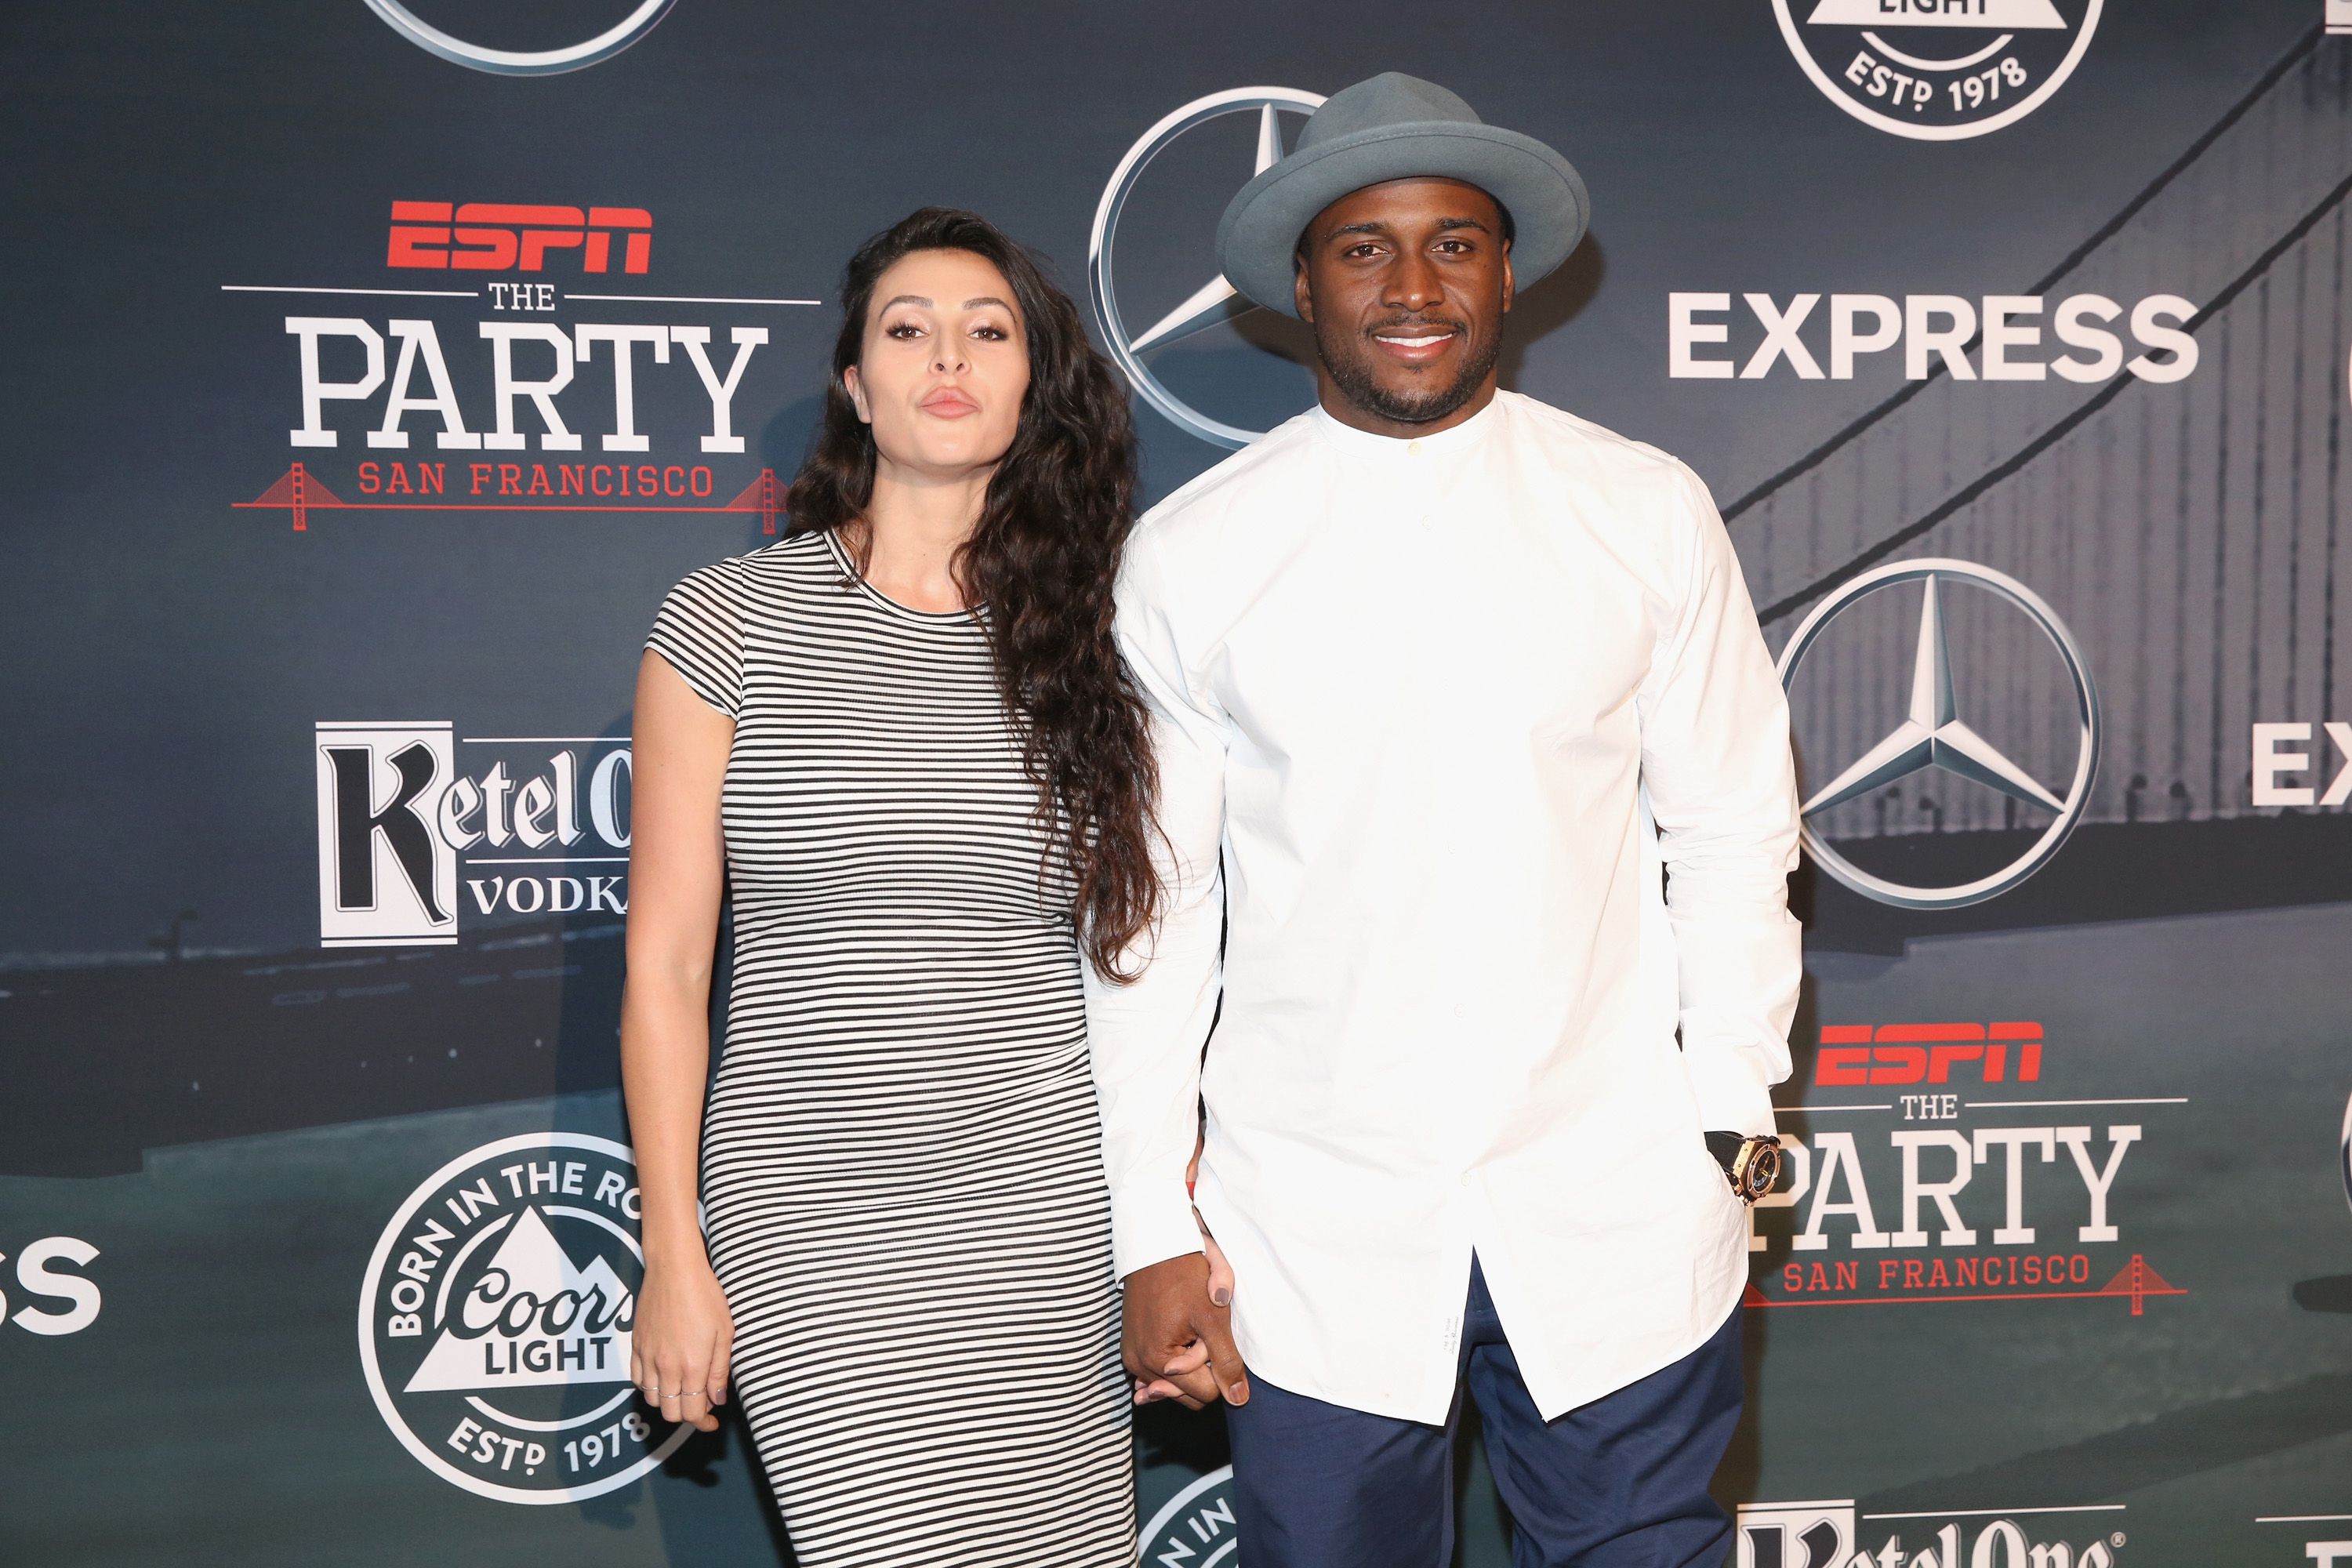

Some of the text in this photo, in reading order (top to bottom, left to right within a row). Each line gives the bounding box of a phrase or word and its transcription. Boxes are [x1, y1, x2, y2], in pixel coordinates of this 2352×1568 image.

[1947, 56, 2027, 111] 1978
[387, 200, 652, 274] ESPN
[488, 282, 556, 311] THE
[1668, 292, 2199, 383] EXPRESS
[285, 316, 769, 453] PARTY
[358, 461, 713, 497] SAN FRANCISCO
[320, 739, 586, 927] Ketel
[466, 876, 629, 915] VODK
[1815, 1022, 2044, 1087] ESPN
[1900, 1094, 1958, 1120] THE
[388, 1218, 456, 1338] BORN
[446, 1177, 499, 1226] IN
[500, 1161, 587, 1199] THE
[1783, 1254, 2089, 1292] SAN FRANCISCO
[0, 1236, 101, 1336] S
[485, 1337, 612, 1375] LIGHT
[564, 1412, 652, 1472] 1978
